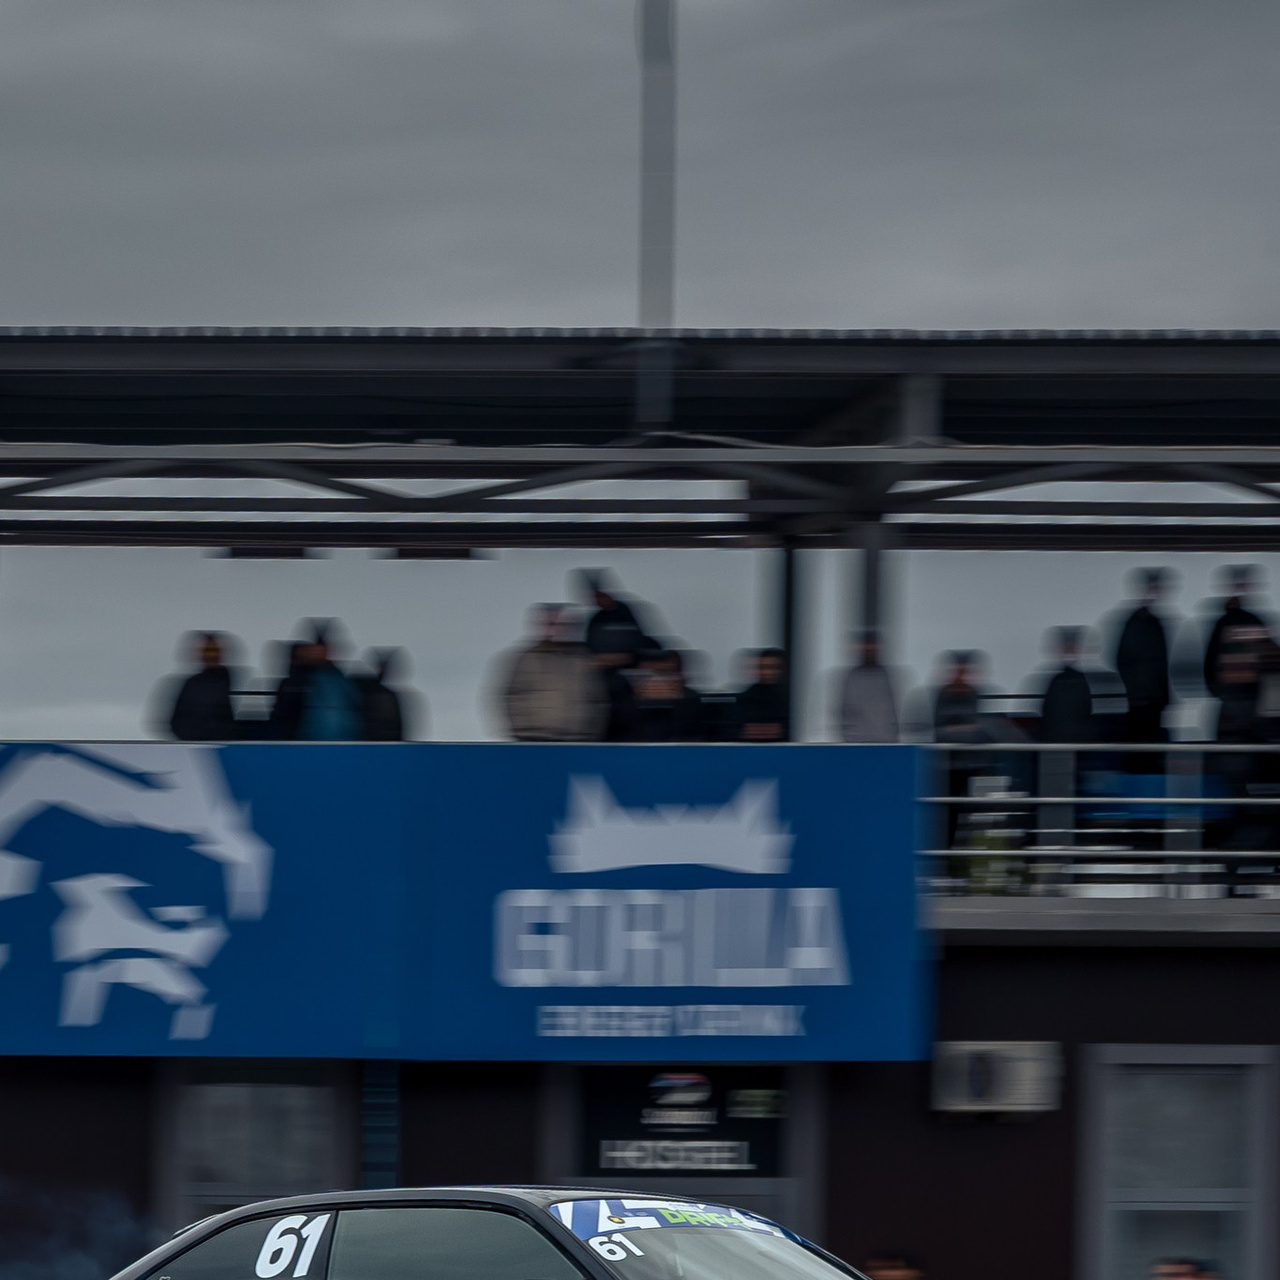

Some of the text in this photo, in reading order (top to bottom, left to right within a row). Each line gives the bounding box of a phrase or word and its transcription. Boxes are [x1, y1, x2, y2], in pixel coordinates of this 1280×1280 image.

[493, 888, 852, 987] GORILLA
[255, 1213, 331, 1279] 61
[588, 1233, 645, 1261] 61
